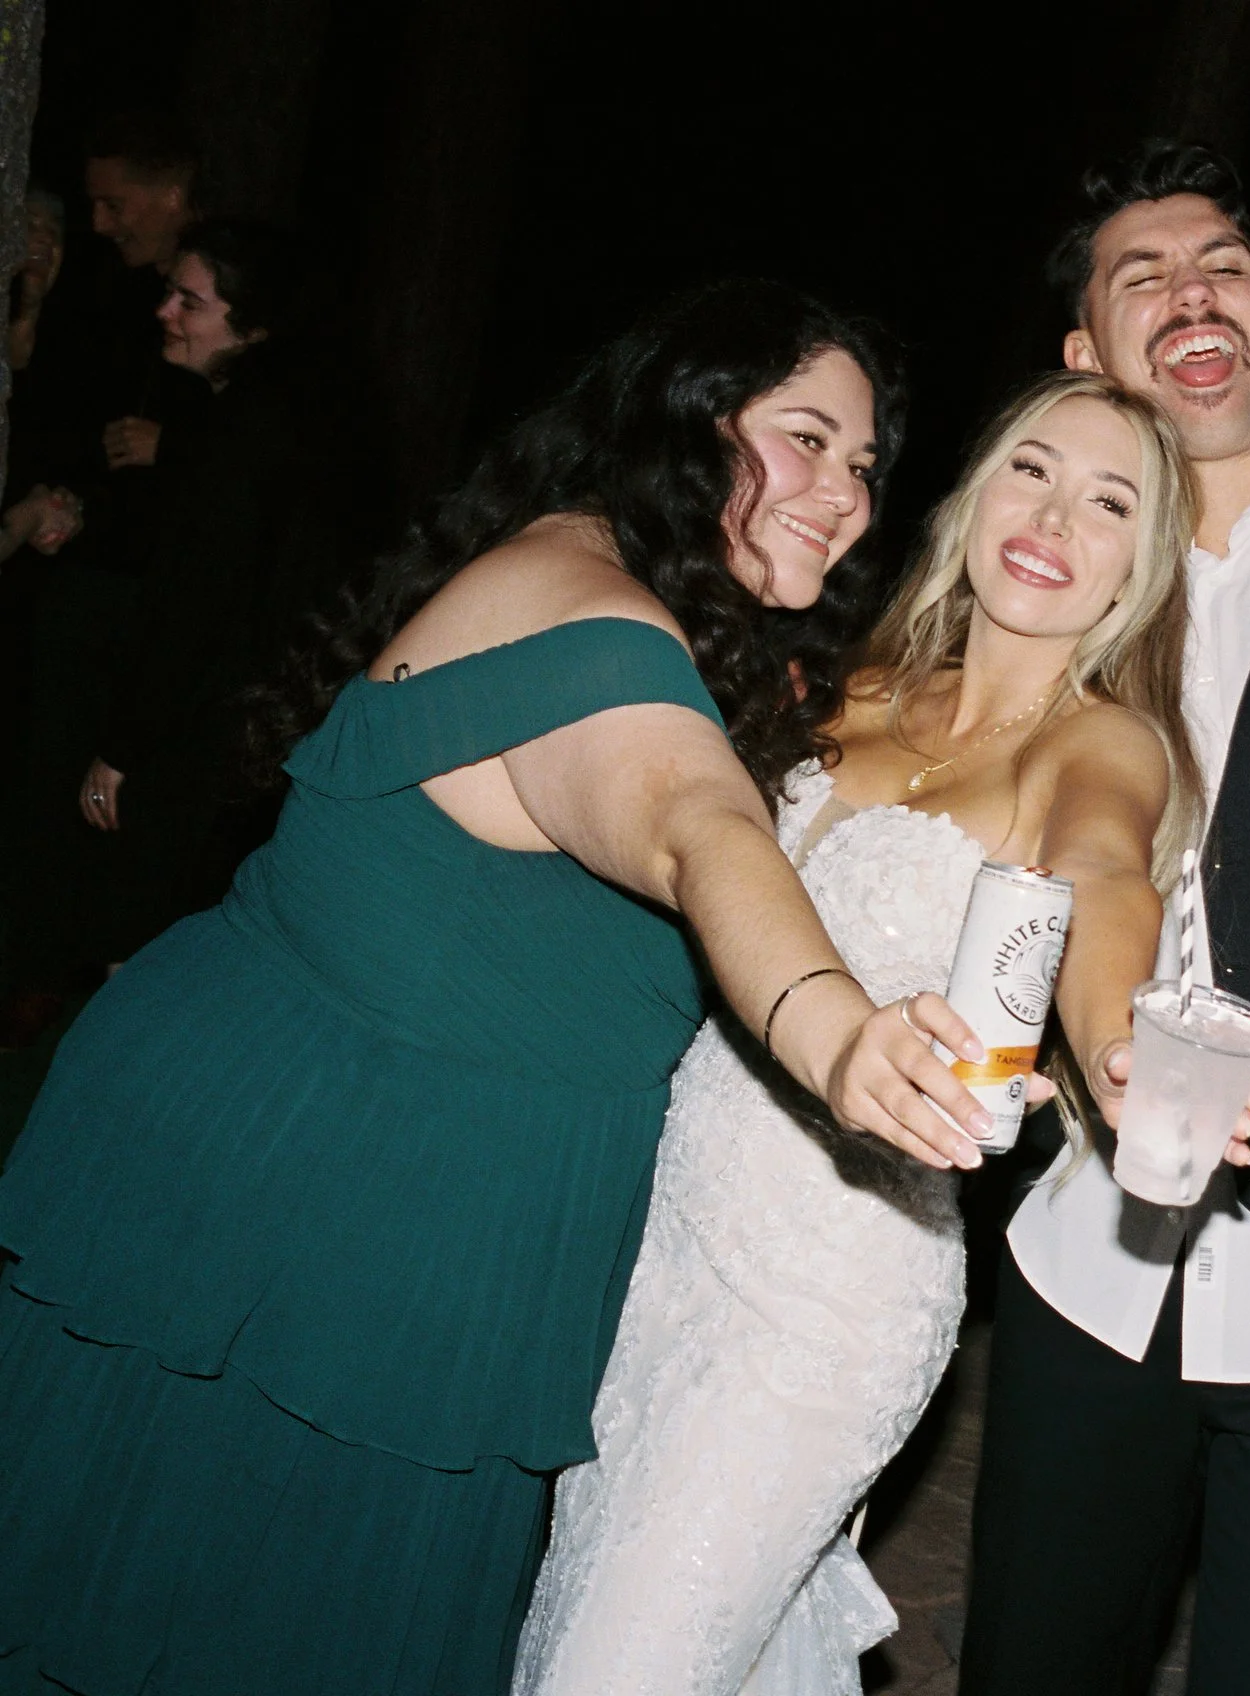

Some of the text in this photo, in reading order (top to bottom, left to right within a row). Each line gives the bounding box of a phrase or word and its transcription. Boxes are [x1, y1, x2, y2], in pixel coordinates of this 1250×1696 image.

[993, 916, 1065, 977] WHITE CL
[1005, 992, 1036, 1019] HARD
